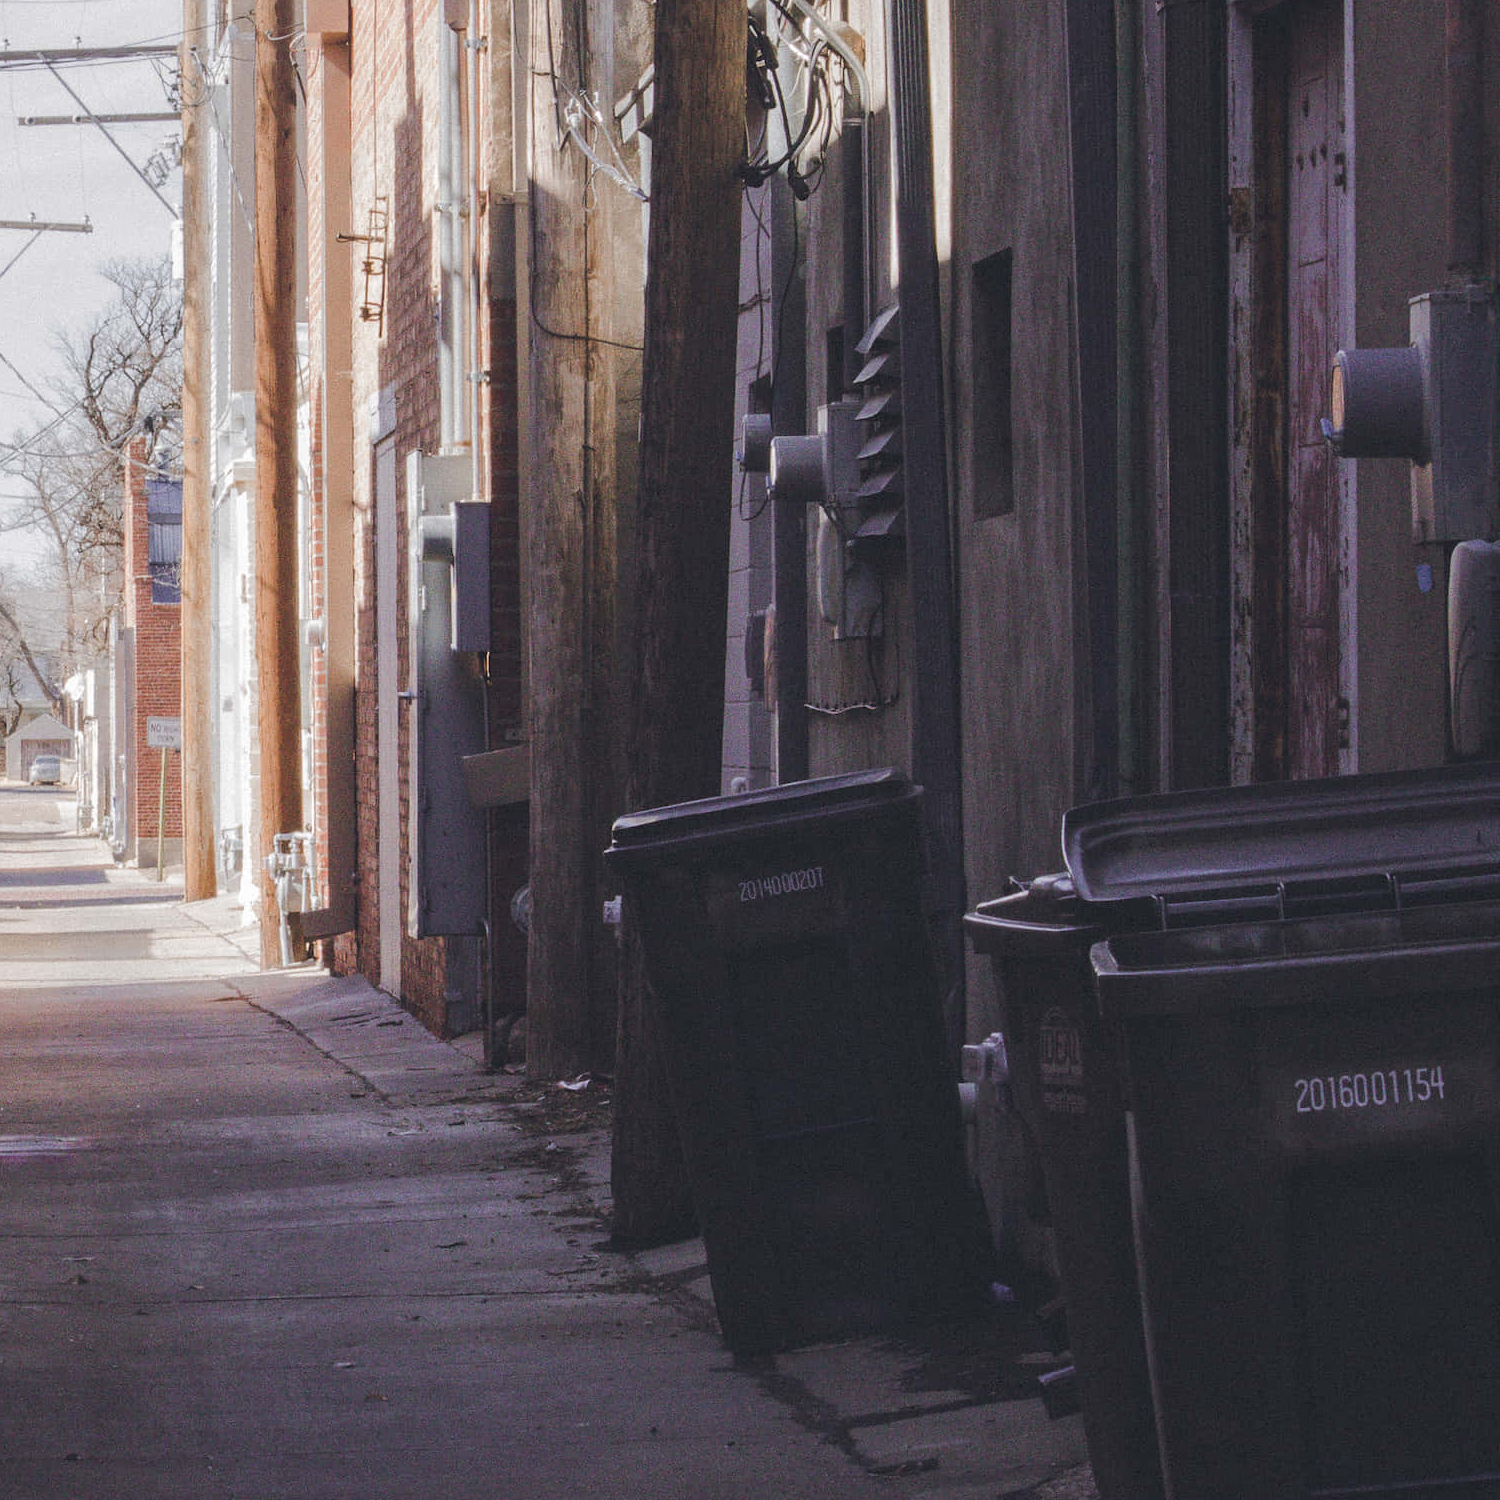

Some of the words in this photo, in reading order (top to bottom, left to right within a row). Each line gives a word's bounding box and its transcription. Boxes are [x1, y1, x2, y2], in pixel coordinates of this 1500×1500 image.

[150, 723, 162, 733] NO
[737, 867, 824, 902] 2014000207
[1294, 1065, 1445, 1113] 2016001154
